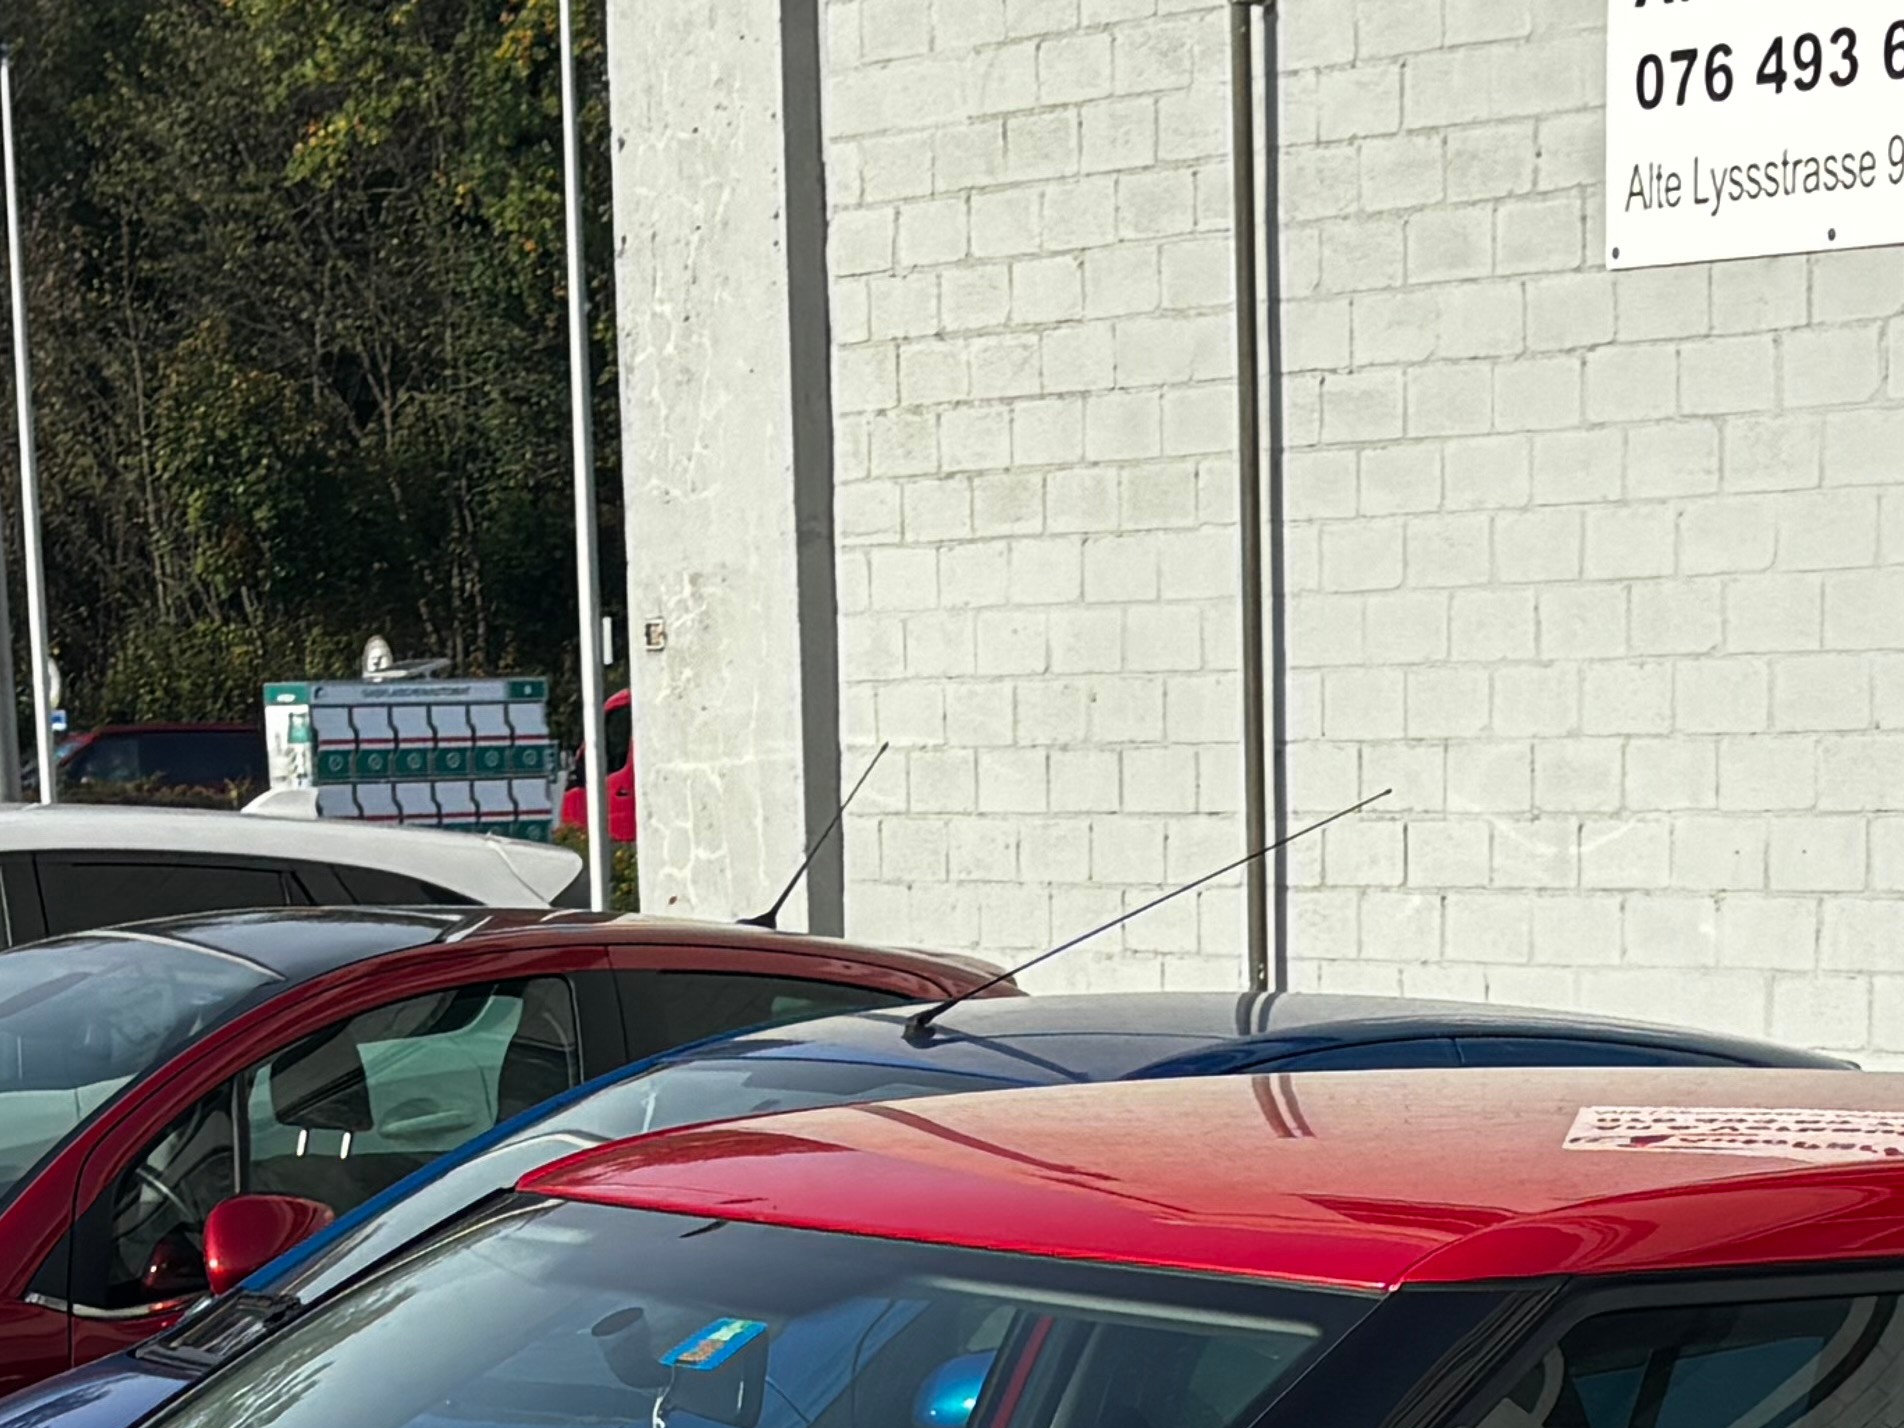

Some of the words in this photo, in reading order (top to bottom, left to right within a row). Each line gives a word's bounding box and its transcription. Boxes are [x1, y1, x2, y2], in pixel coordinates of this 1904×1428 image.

[1635, 43, 1733, 110] 076
[1756, 27, 1858, 94] 493
[1625, 162, 1681, 212] Alte
[1694, 149, 1876, 216] Lyssstrasse
[1888, 135, 1904, 185] 9
